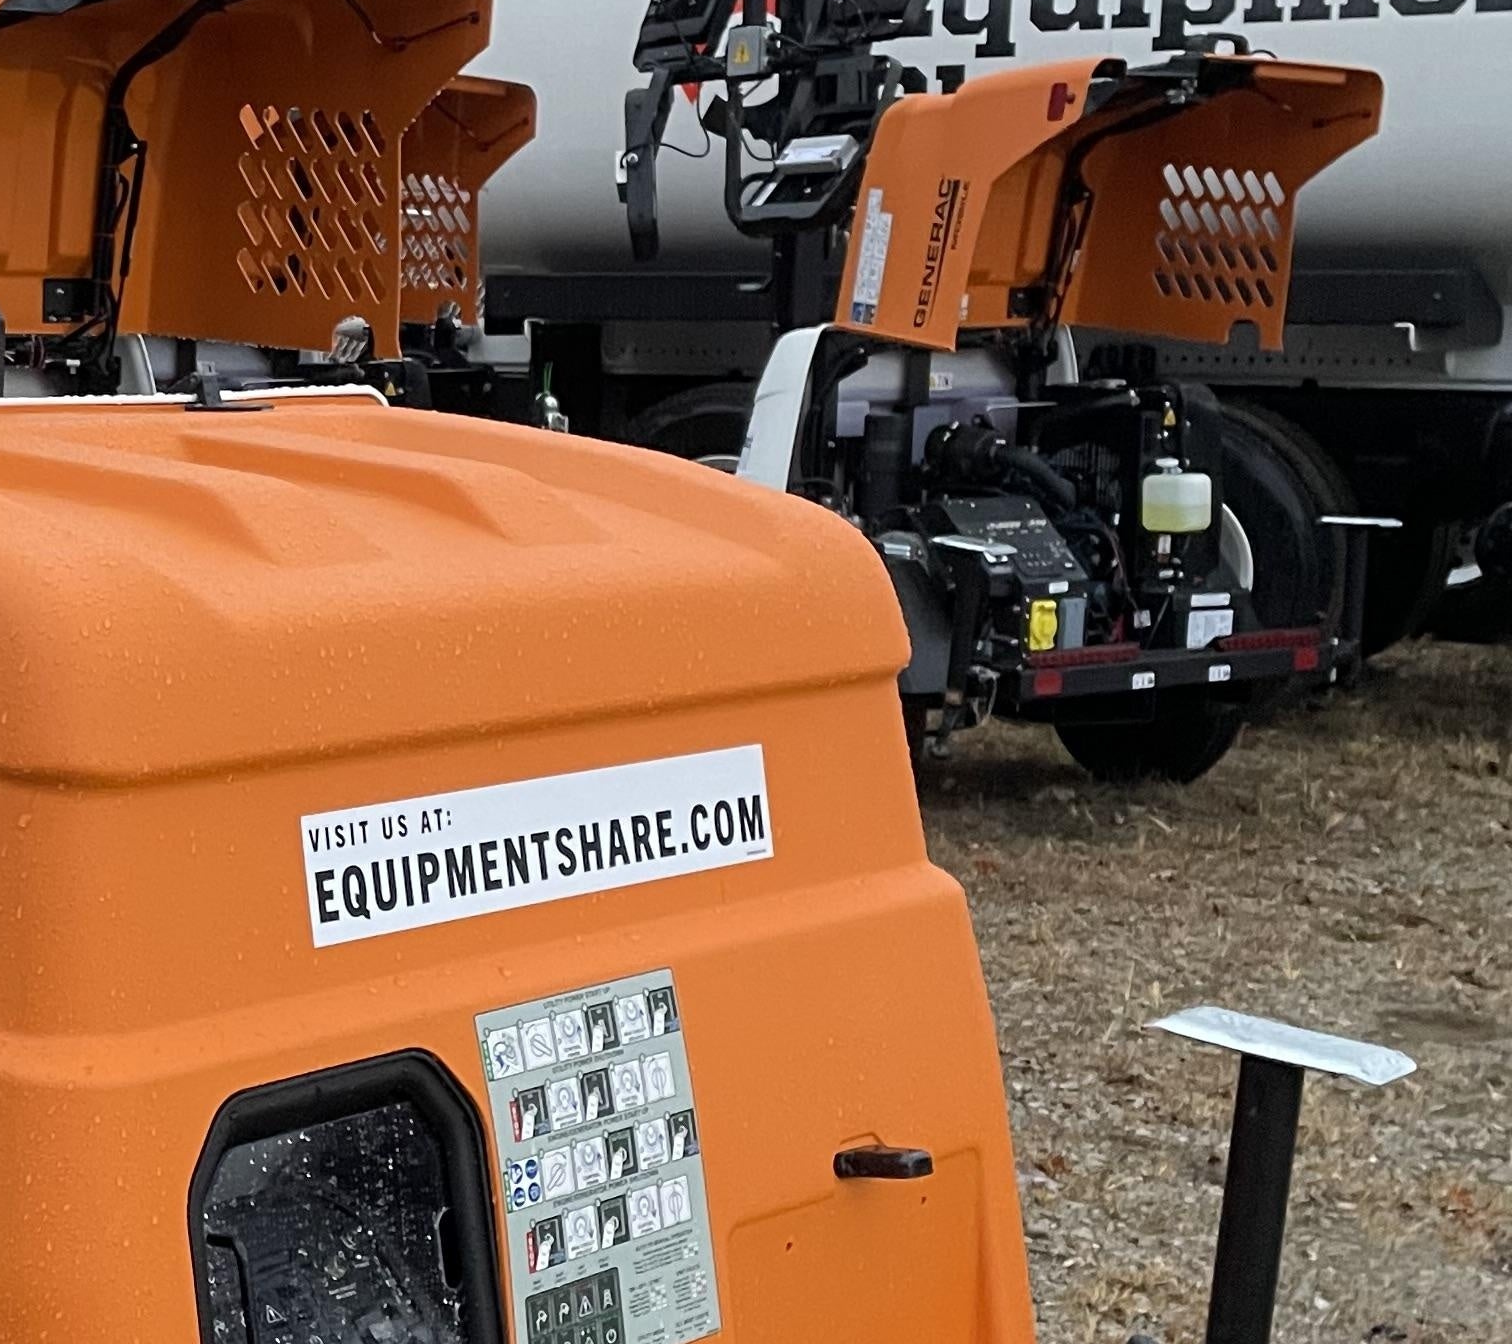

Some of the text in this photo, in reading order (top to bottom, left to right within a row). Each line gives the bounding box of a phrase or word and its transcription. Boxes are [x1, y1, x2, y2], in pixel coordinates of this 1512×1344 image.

[913, 178, 952, 328] GENERAC
[308, 808, 453, 853] VISIT US AT:
[313, 794, 766, 924] EQUIPMENTSHARE.COM
